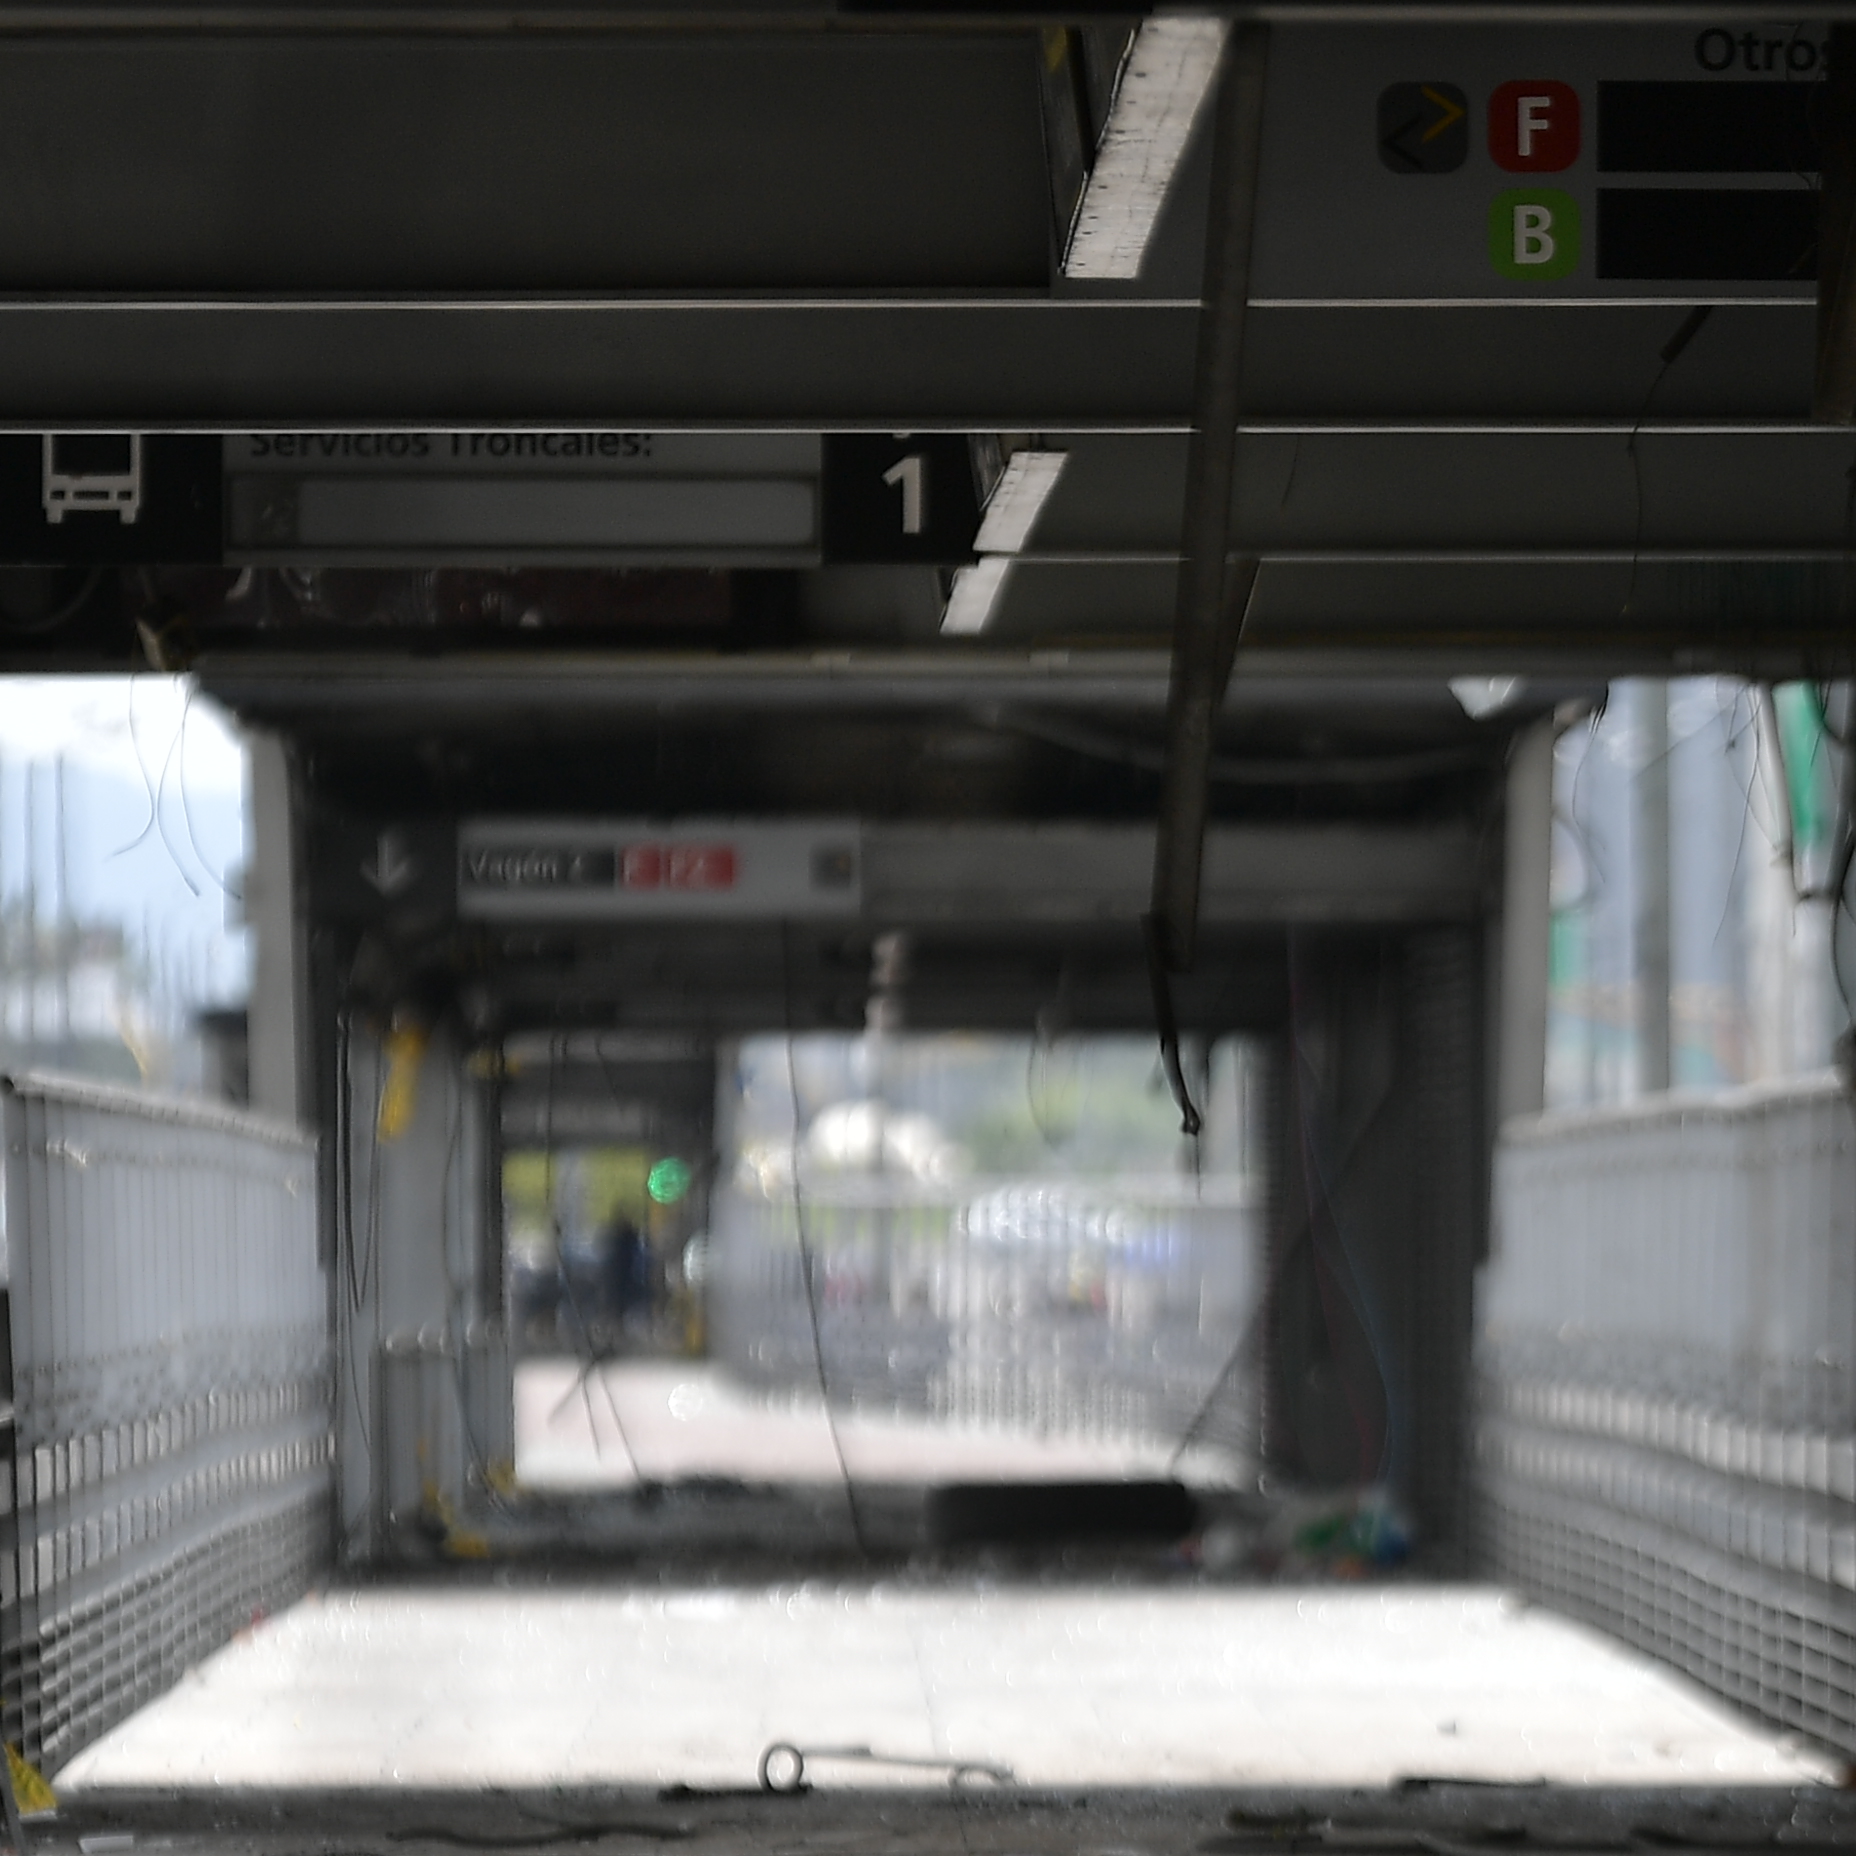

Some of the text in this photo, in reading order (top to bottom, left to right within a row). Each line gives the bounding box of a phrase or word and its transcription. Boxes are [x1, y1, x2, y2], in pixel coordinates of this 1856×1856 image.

[1693, 27, 1830, 72] Otro
[1516, 96, 1551, 157] F
[1513, 204, 1555, 265] B
[880, 454, 922, 535] 1
